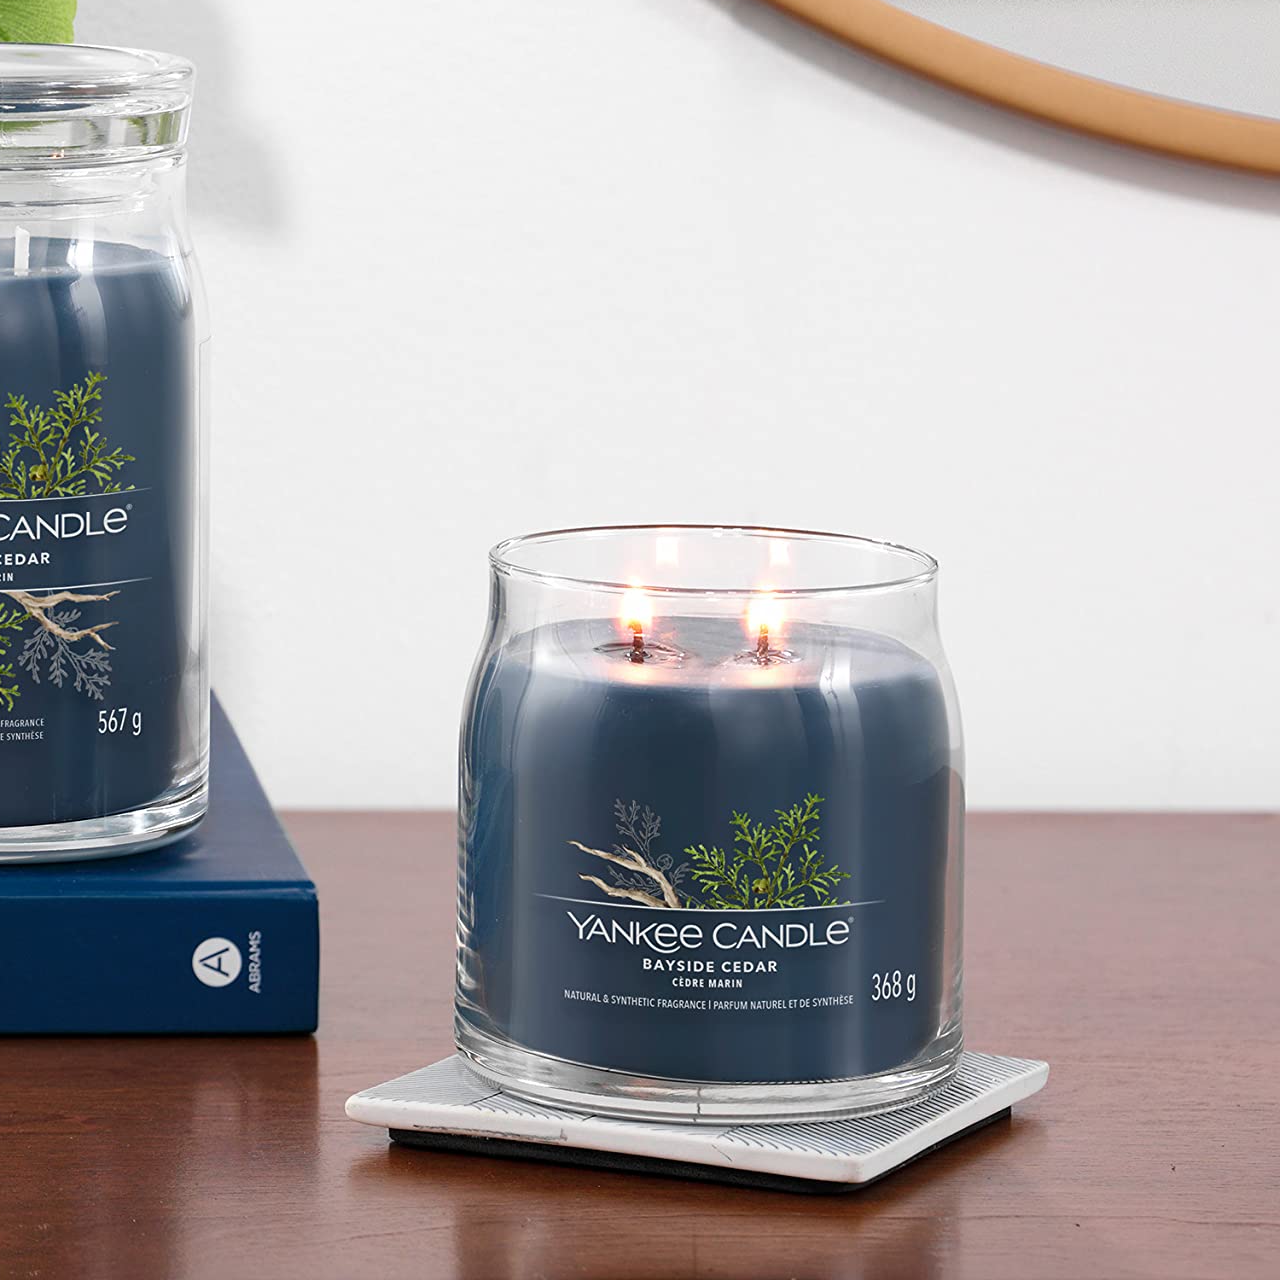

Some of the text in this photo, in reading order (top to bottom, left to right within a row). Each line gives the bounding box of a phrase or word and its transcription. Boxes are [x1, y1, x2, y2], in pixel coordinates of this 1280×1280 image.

[0, 718, 45, 728] FRAGRANCE
[98, 707, 142, 737] 567 g
[199, 947, 230, 978] A
[248, 930, 262, 994] ABRAMS
[643, 958, 778, 973] BAYSIDE CEDAR
[672, 975, 743, 988] CÈDRE MARIN
[871, 970, 917, 1002] 368 g
[564, 989, 601, 1003] NATURAL
[602, 994, 610, 1004] &
[611, 995, 655, 1007] SYNTHETIC
[657, 998, 706, 1010] FRAGRANCE
[713, 999, 748, 1010] PARFUM
[750, 999, 787, 1010] NATUREL
[788, 999, 798, 1009] ET
[800, 998, 810, 1008] DE
[812, 994, 854, 1007] SYNTHÈSE
